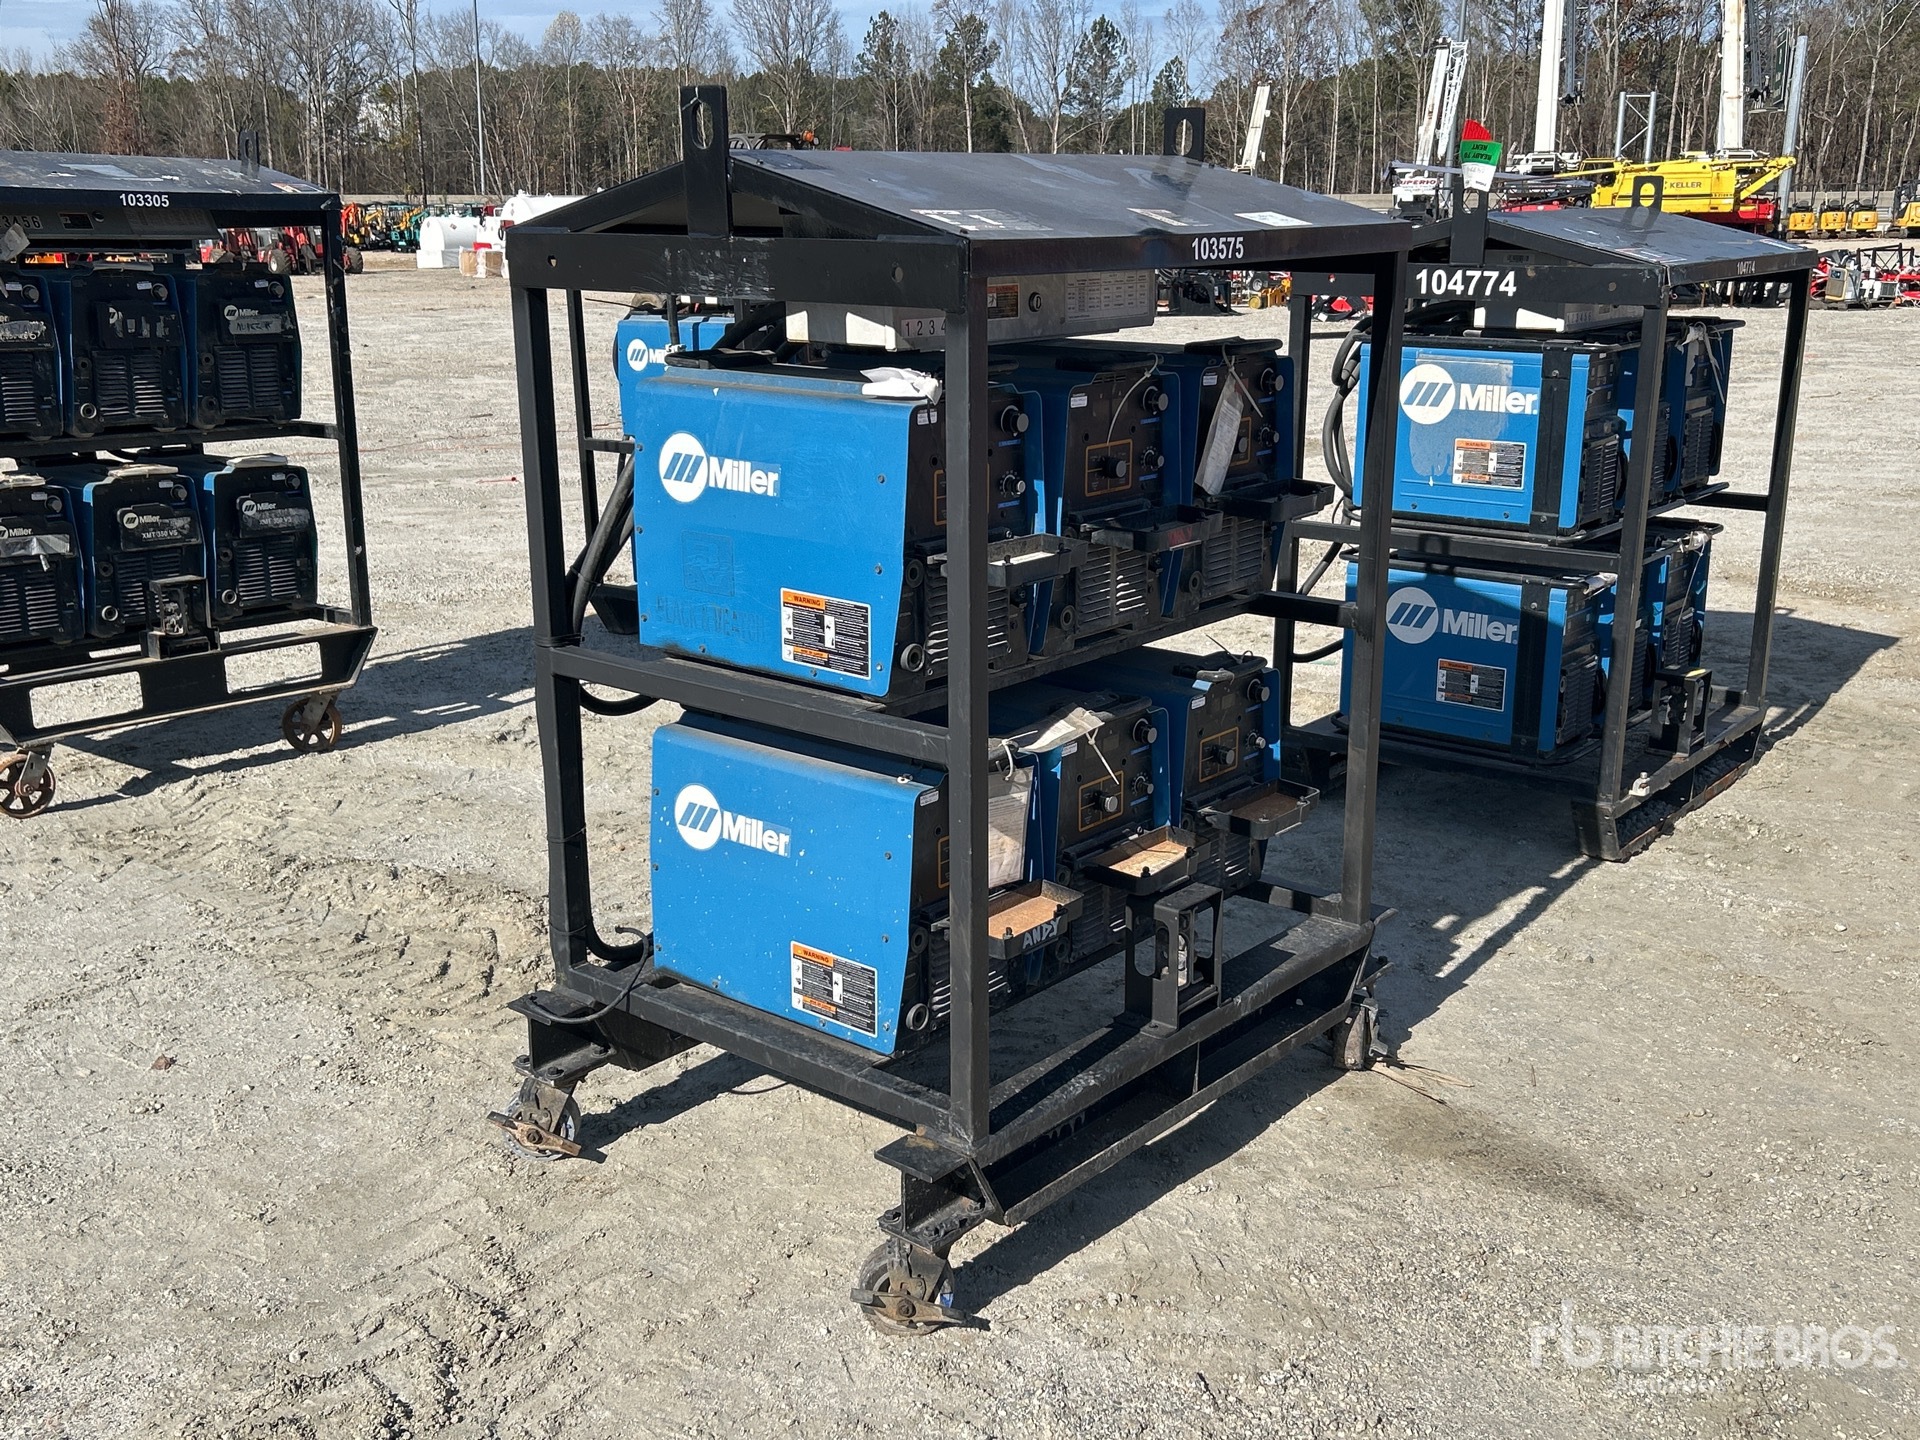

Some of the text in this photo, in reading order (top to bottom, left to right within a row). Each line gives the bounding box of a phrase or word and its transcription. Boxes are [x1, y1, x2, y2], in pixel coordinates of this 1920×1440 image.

[119, 193, 170, 208] 103305
[1192, 236, 1245, 261] 103575
[1416, 268, 1517, 297] 104774
[240, 308, 259, 316] Miller
[1459, 383, 1538, 415] Miller
[708, 456, 779, 497] Miller
[257, 502, 277, 510] Miller
[139, 514, 160, 523] Miller
[9, 528, 33, 537] Miller
[793, 595, 821, 606] WARNING
[1441, 608, 1518, 645] Miller
[722, 810, 791, 857] Miller
[1022, 915, 1062, 949] ANDY
[802, 949, 830, 964] WARNING
